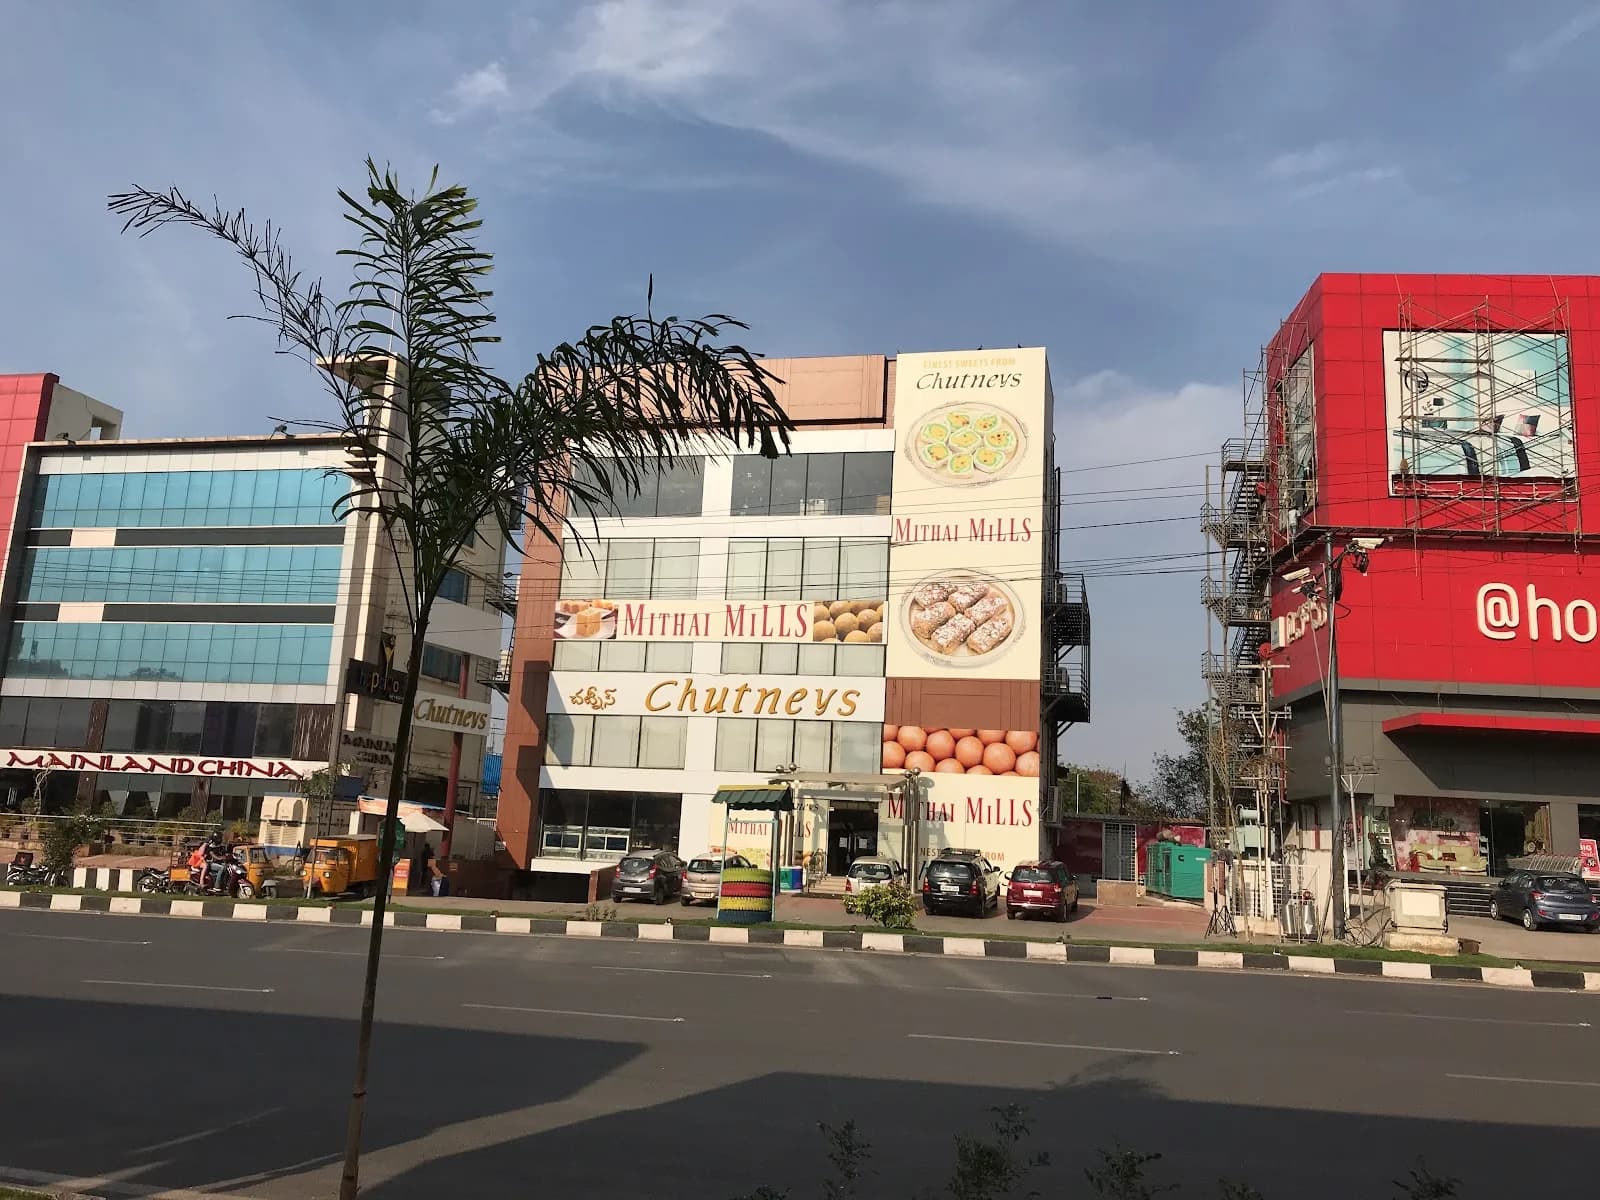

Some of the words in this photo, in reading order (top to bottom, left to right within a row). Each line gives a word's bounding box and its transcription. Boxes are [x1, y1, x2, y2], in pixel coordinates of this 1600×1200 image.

[917, 372, 1022, 389] Chutneys
[645, 678, 861, 717] Chutneys
[414, 698, 488, 730] Chutneys
[888, 792, 954, 822] MHAI
